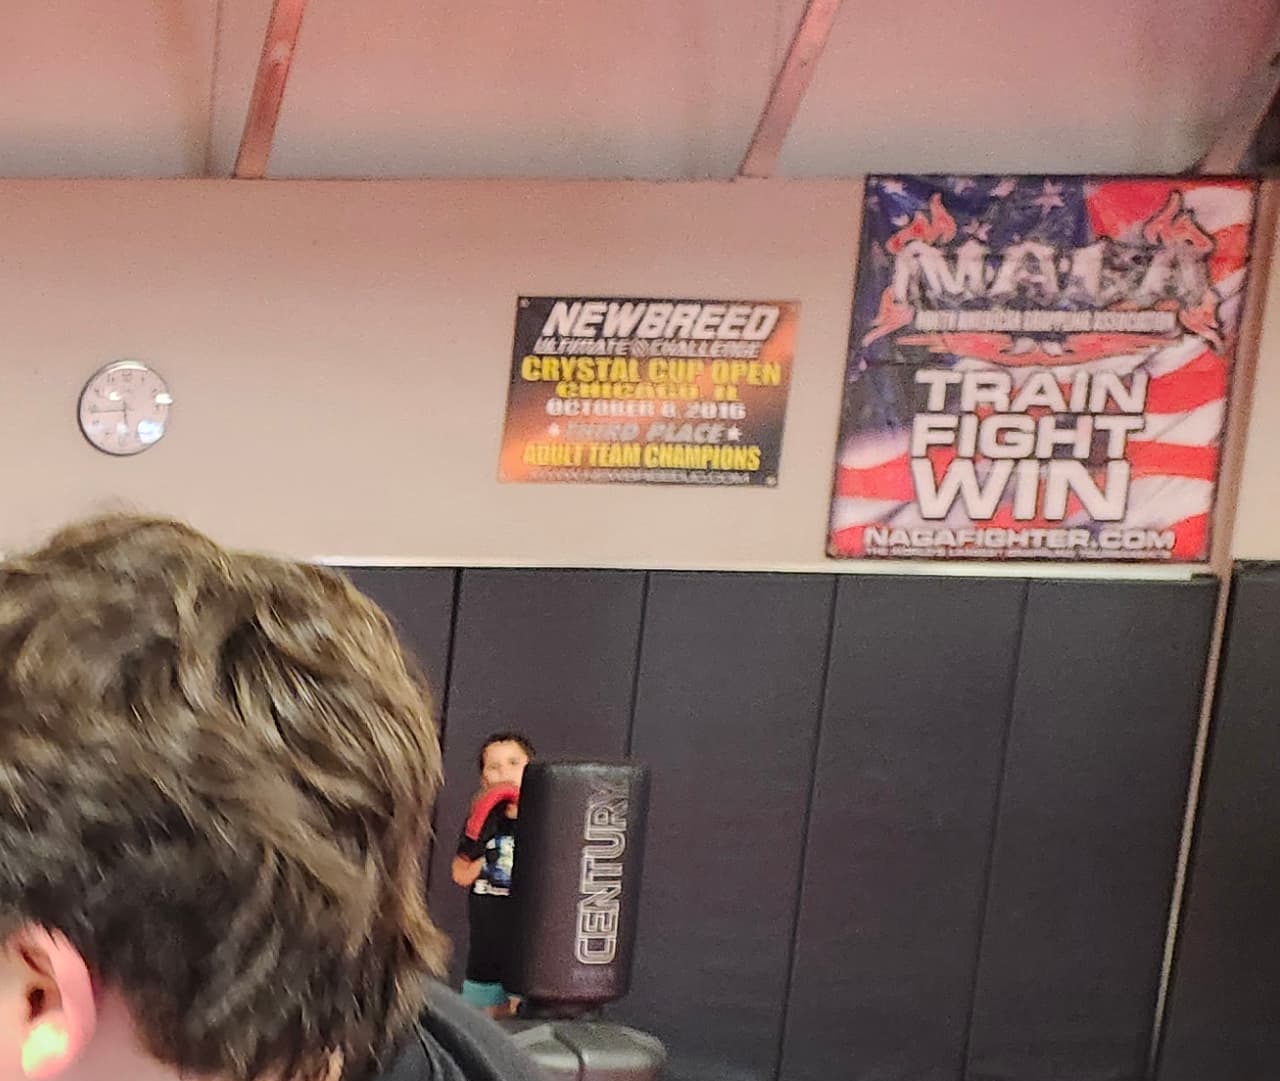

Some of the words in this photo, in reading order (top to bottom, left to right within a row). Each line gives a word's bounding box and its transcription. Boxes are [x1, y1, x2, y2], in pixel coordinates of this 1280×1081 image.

[542, 300, 781, 341] NEWBREED
[521, 355, 641, 382] CRYSTAL
[648, 357, 705, 384] CUP
[711, 360, 782, 386] OPEN
[545, 398, 655, 417] OCTOBER
[915, 368, 1150, 413] TRAIN
[646, 422, 727, 443] PLACE
[911, 413, 1144, 459] FIGHT
[522, 443, 582, 466] ADULT
[589, 444, 641, 468] TEAM
[643, 446, 762, 472] CHAMPIONS
[911, 458, 1131, 521] WIN
[863, 527, 1176, 550] NAGAFIGHTER.COM
[576, 778, 630, 965] CENTURY
